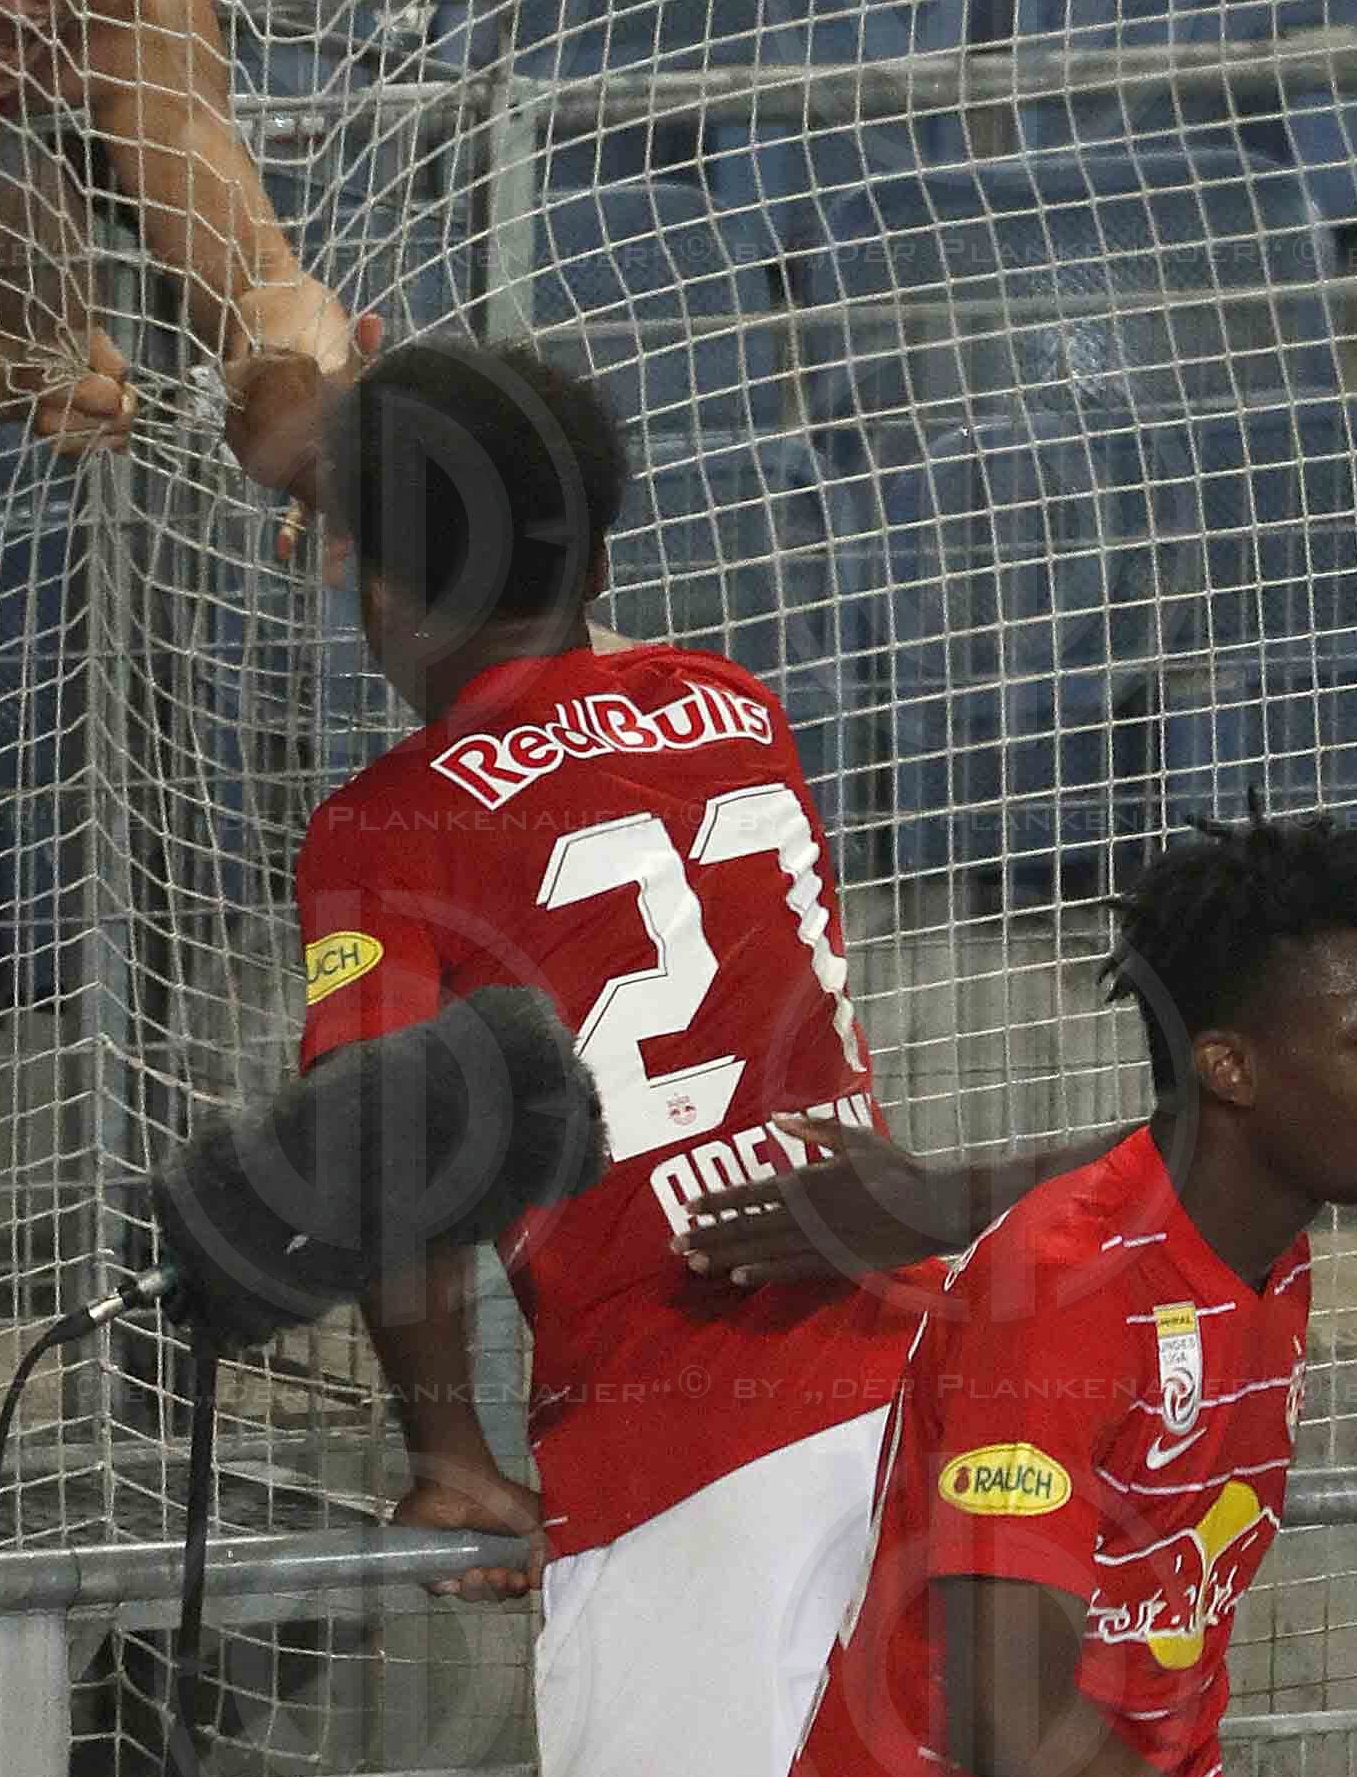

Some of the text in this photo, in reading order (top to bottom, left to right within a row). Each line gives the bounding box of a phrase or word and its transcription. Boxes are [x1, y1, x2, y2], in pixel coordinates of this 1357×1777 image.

[305, 941, 361, 984] UCH
[535, 782, 868, 1164] 27
[972, 1465, 1054, 1500] RAUCH
